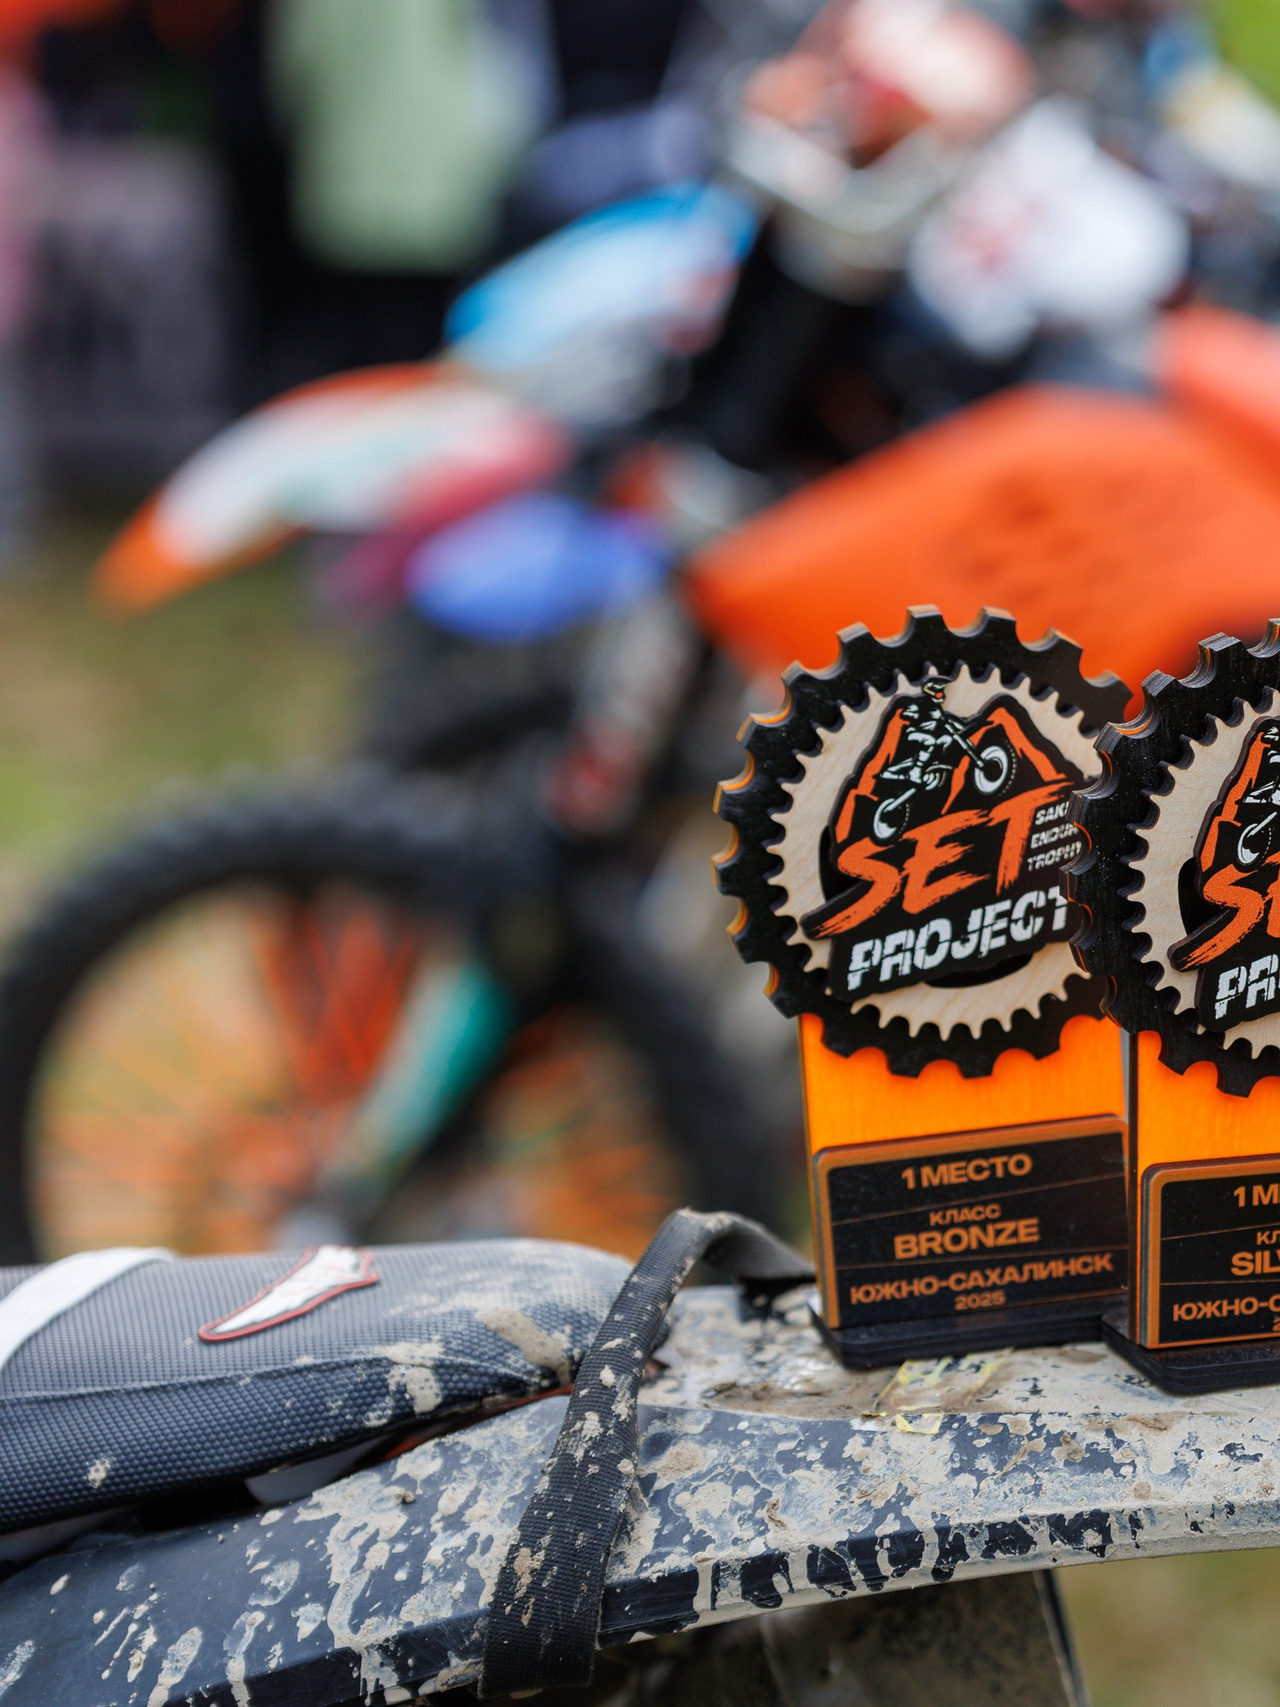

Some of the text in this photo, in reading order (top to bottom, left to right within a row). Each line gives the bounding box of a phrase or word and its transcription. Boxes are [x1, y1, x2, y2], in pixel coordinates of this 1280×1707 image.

[1030, 822, 1079, 849] ENDUR
[810, 781, 1077, 938] SET
[846, 885, 1069, 991] PROJECT
[901, 1153, 1033, 1190] 1 МЕСТО
[929, 1203, 1002, 1226] КЛАСС
[1233, 1186, 1246, 1207] 1
[893, 1217, 1041, 1260] BRONZE
[850, 1252, 1114, 1305] ЮЖНО-САХАЛИНСК
[953, 1290, 1006, 1311] 2025
